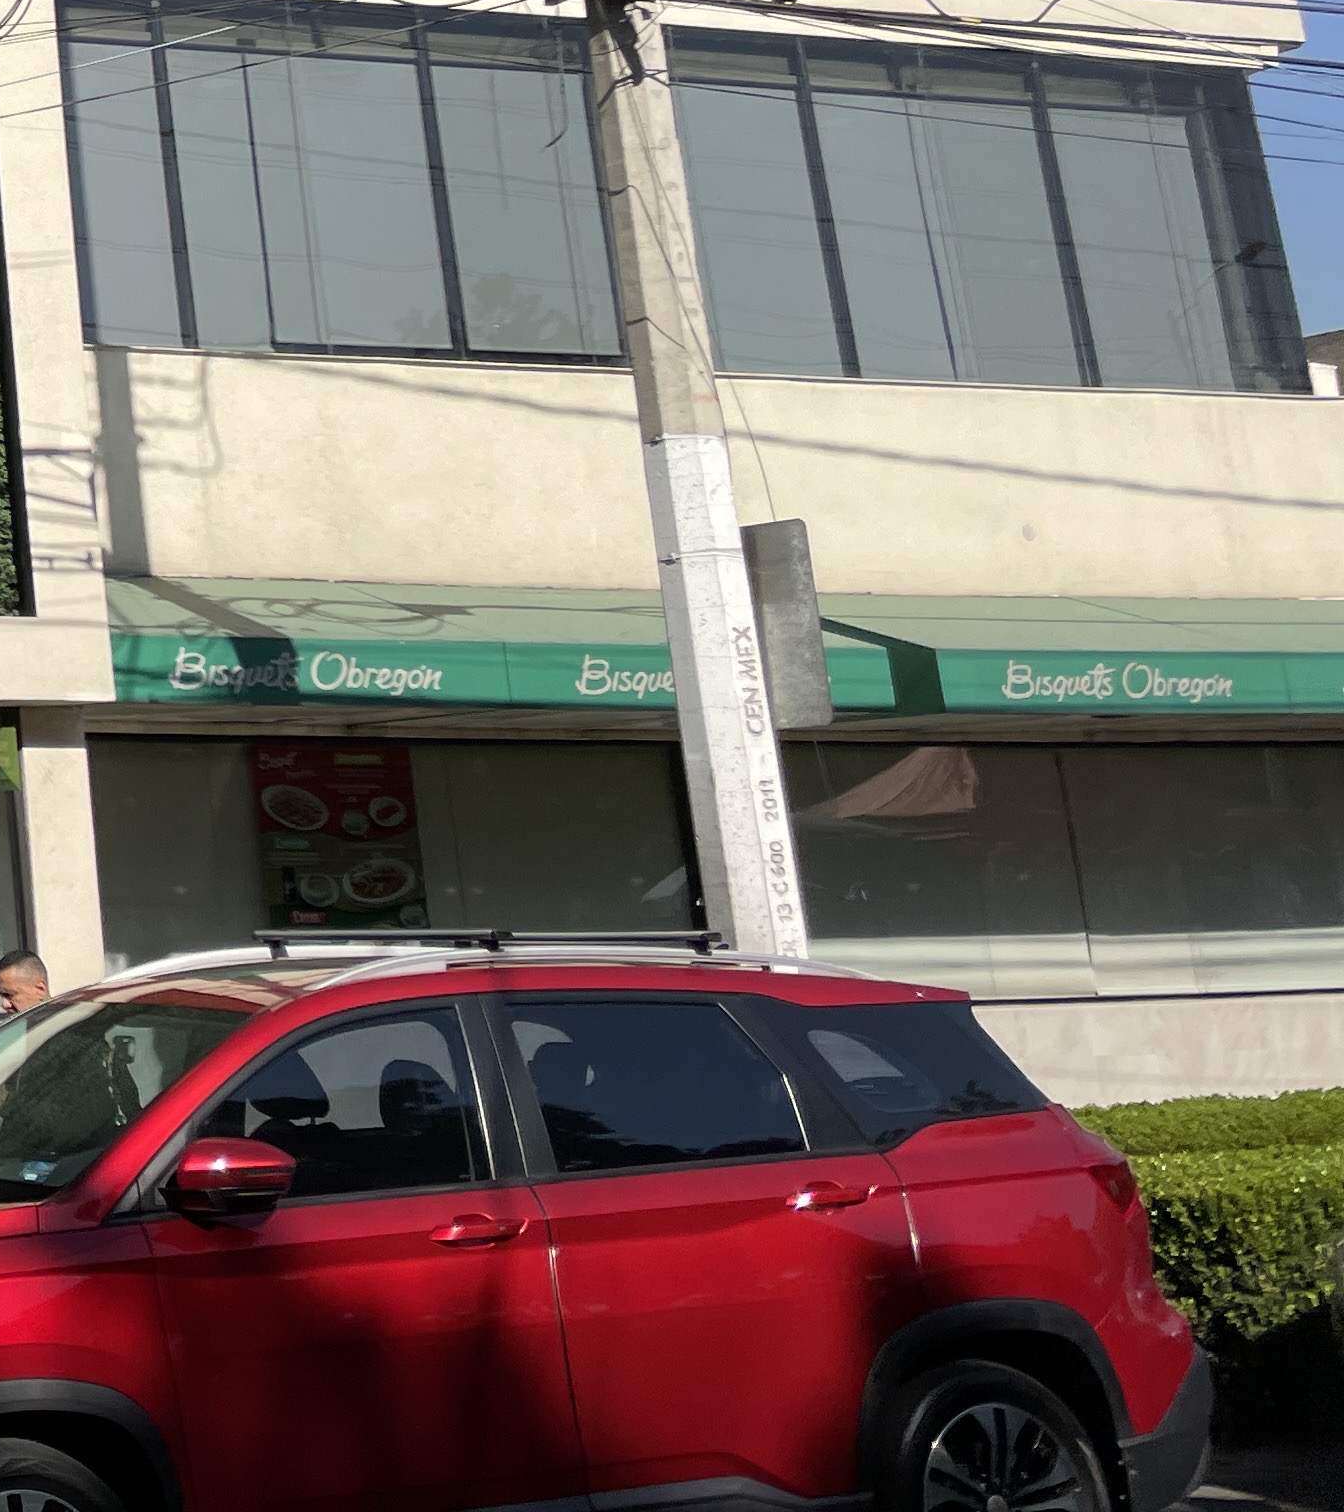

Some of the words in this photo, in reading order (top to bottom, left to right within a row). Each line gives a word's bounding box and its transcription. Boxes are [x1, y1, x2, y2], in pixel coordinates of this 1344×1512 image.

[168, 646, 304, 694] Bisquets
[310, 651, 443, 696] Obregón
[575, 654, 676, 700] Bisque
[1002, 660, 1116, 702] Bisquets
[1123, 662, 1233, 703] Obregón
